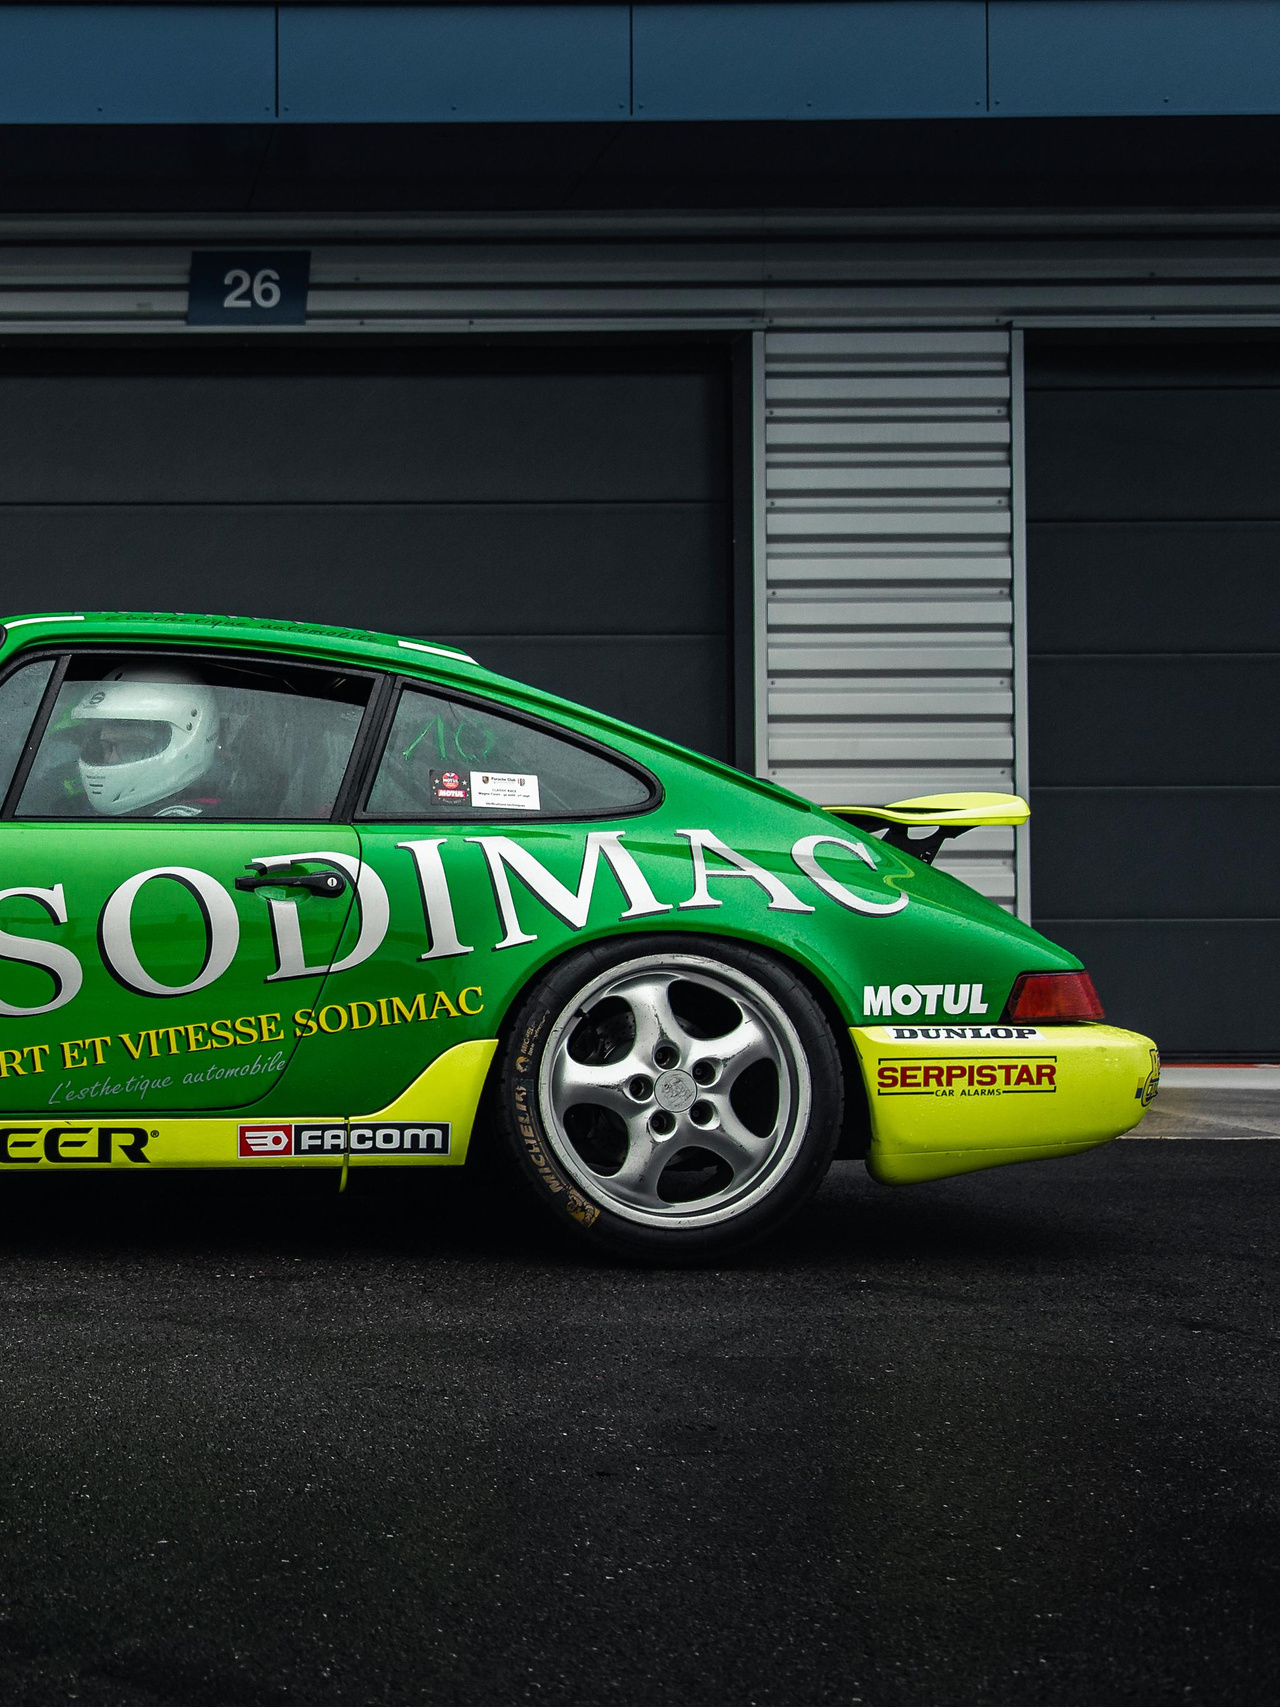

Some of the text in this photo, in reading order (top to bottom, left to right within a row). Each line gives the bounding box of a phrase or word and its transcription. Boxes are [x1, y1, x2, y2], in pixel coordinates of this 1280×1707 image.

[223, 269, 281, 308] 26
[438, 789, 464, 798] MOTUL
[863, 983, 988, 1016] MOTUL
[59, 1035, 111, 1070] ET
[117, 1012, 285, 1061] VITESSE
[292, 986, 485, 1040] SODIMAC
[892, 1027, 1037, 1040] DUNLOP
[48, 1051, 288, 1106] L'esthetique automobile
[877, 1064, 1057, 1088] SERPISTAR
[935, 1088, 1002, 1097] CAR ALARMS
[300, 1127, 444, 1152] FACOM
